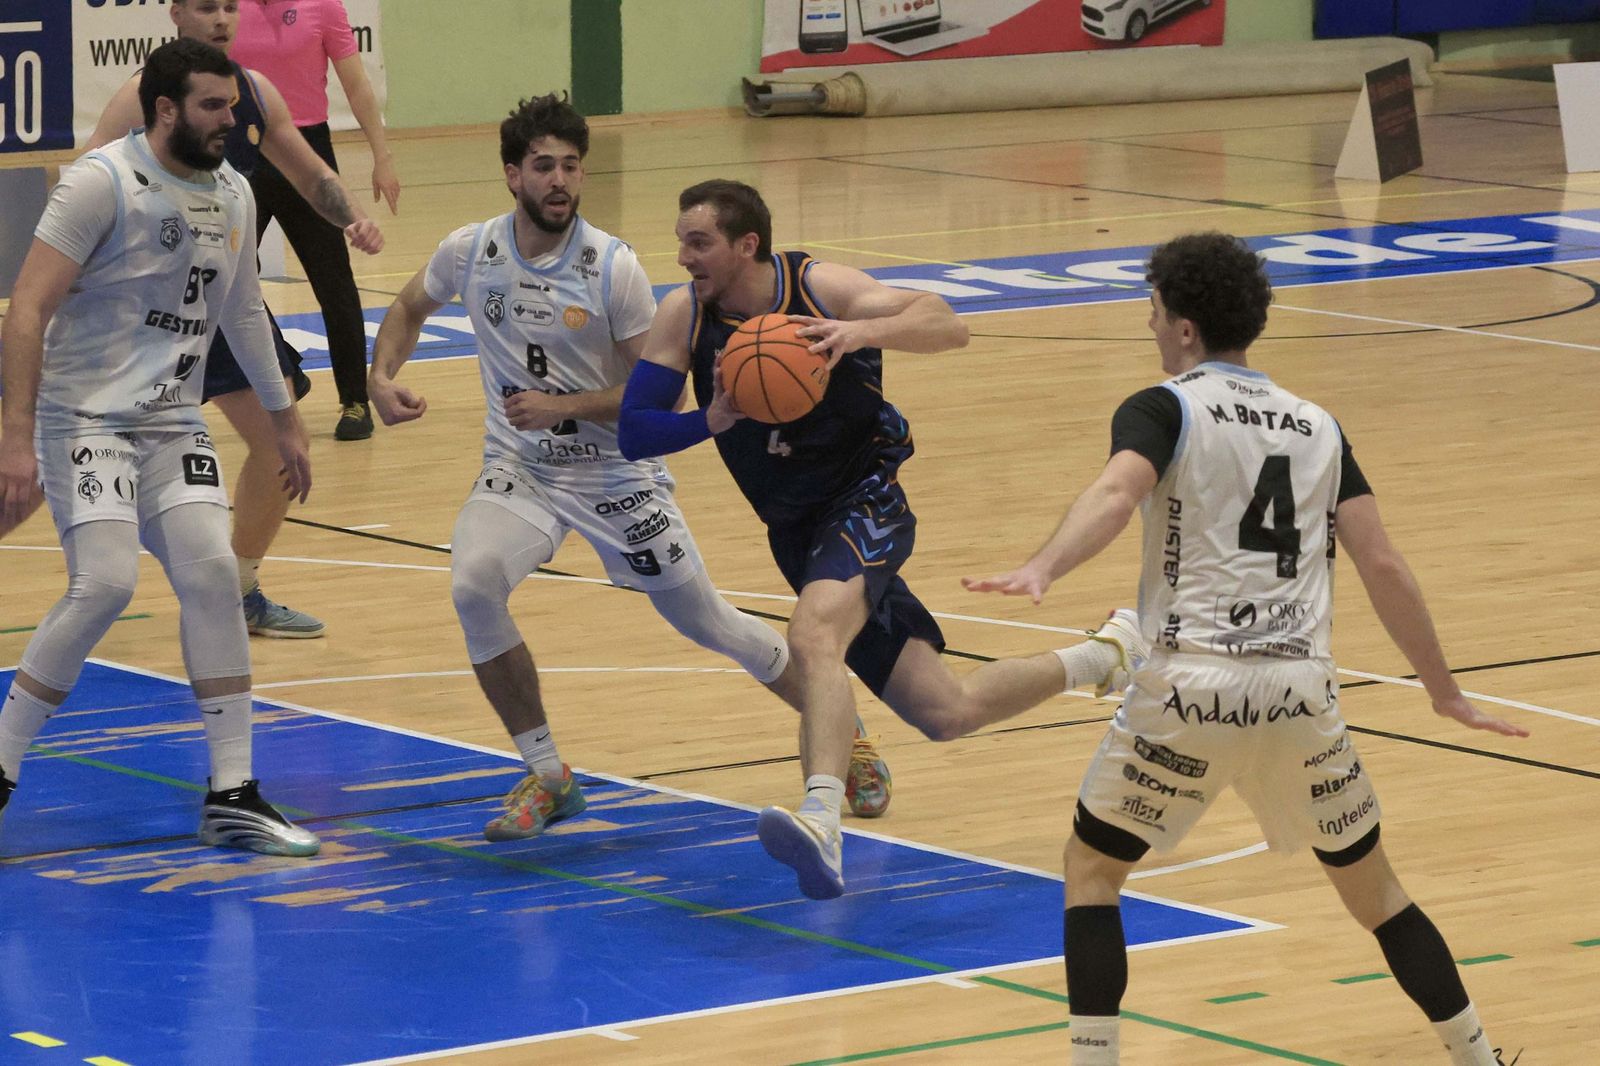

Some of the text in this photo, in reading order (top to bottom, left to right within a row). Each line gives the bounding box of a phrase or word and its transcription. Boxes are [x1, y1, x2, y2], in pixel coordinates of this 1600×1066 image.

[0, 50, 42, 144] O
[1255, 231, 1560, 267] de
[527, 343, 548, 379] 8
[1206, 403, 1313, 437] M. BOTAS
[538, 438, 600, 458] Jaén
[767, 430, 792, 457] 4
[190, 459, 213, 476] LZ
[1238, 455, 1301, 579] 4
[1163, 685, 1315, 728] Andalucía
[1137, 771, 1178, 798] EOM
